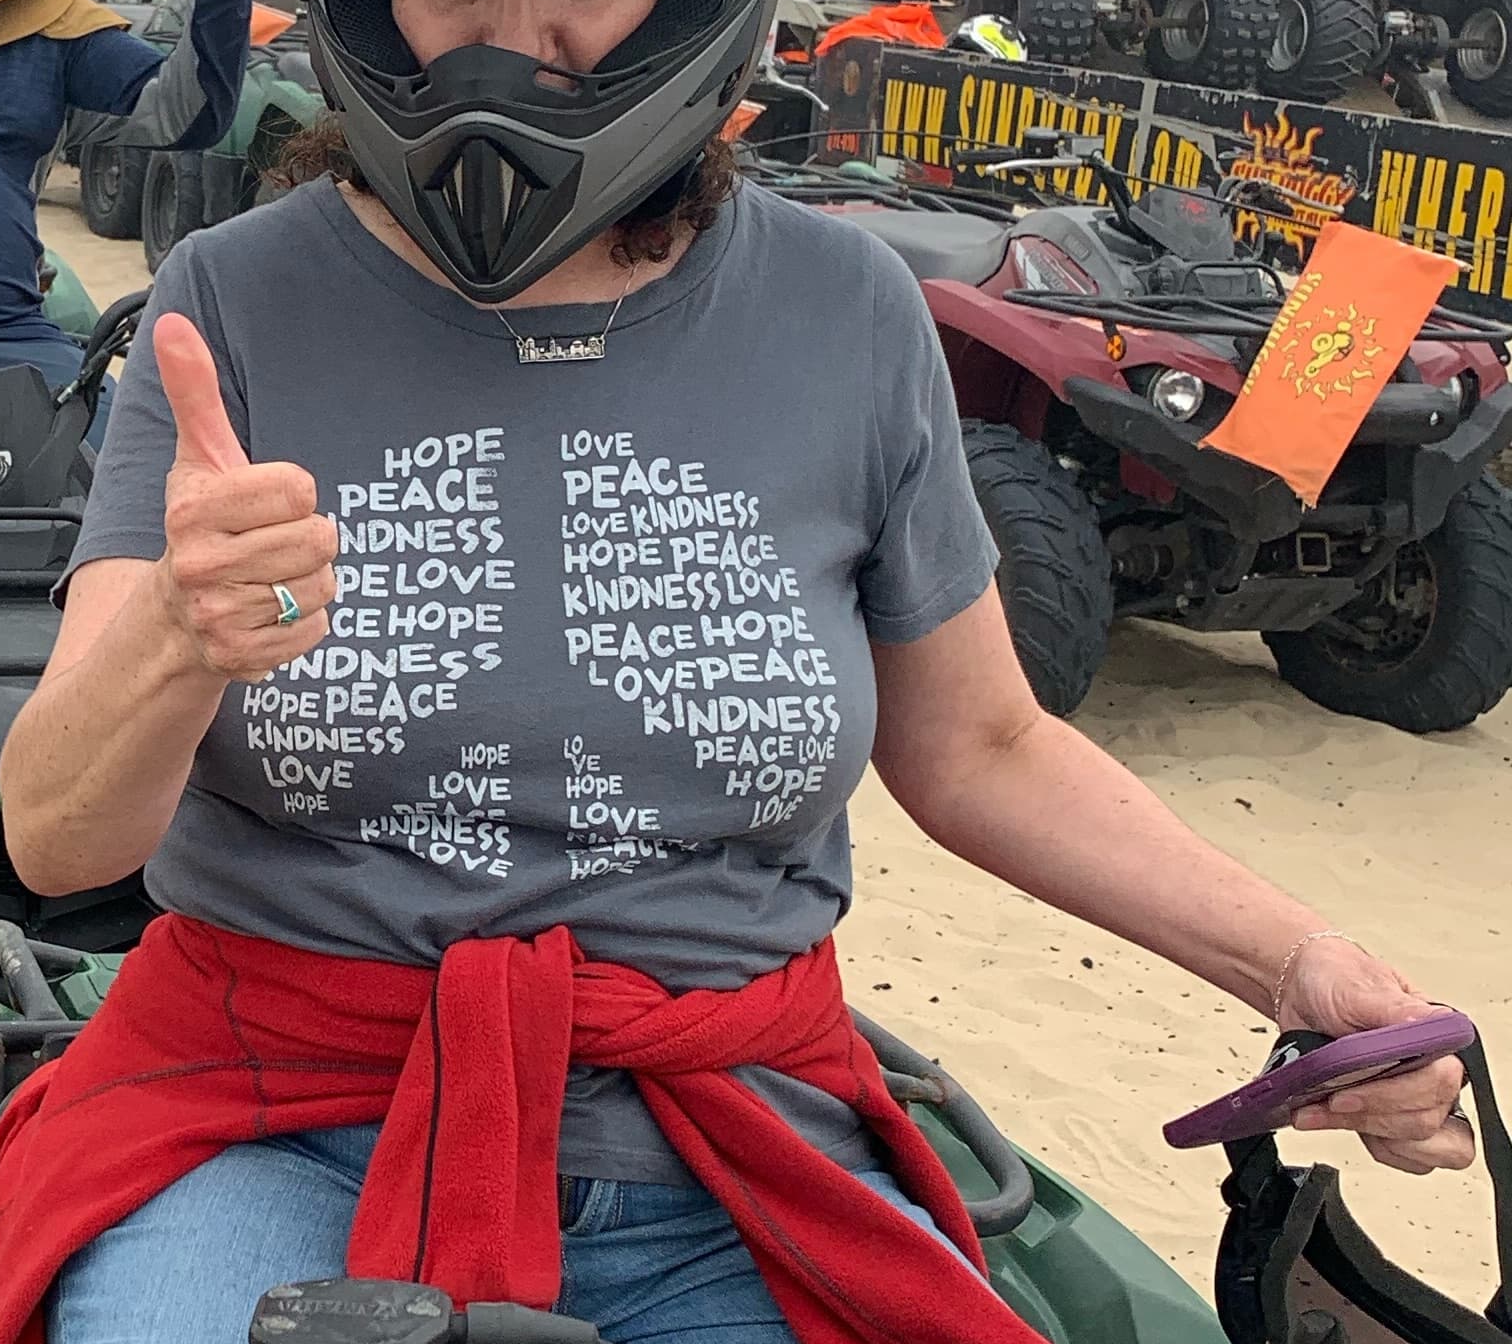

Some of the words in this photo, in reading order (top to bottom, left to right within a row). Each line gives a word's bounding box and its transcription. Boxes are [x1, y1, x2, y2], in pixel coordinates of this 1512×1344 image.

[1373, 149, 1512, 299] WHER
[385, 427, 505, 478] HOPE
[561, 430, 634, 461] LOVE
[337, 467, 499, 517] PEACE
[562, 457, 708, 508] PEACE
[328, 512, 504, 554] NDNESS
[561, 511, 628, 539] LOVE
[630, 491, 759, 536] KINDNESS
[564, 538, 662, 573] HOPE
[670, 530, 778, 573] PEACE
[396, 558, 515, 595] LOVE
[562, 571, 722, 617] KINDNESS
[724, 567, 800, 604] LOVE
[388, 601, 503, 639] HOPE
[565, 621, 696, 665] PEACE
[700, 606, 814, 648] HOPE
[264, 642, 502, 682] NDNESS
[589, 660, 696, 701] LOVE
[696, 648, 836, 690] PEACE
[243, 685, 320, 722] HOPE
[325, 681, 457, 724] PEACE
[642, 692, 840, 736] KINDNESS
[247, 719, 405, 755] KINDNESS
[461, 743, 510, 770] HOPE
[695, 734, 794, 769] PEACE
[799, 735, 835, 764] LOVE
[262, 755, 354, 791] LOVE
[429, 771, 511, 806] LOVE
[566, 774, 623, 799] HOPE
[726, 763, 826, 799] HOPE
[283, 792, 329, 815] HOPE
[569, 802, 661, 835] LOVE
[749, 794, 803, 829] LOVE
[360, 815, 510, 855] KINDNESS
[408, 836, 513, 877] LOVE
